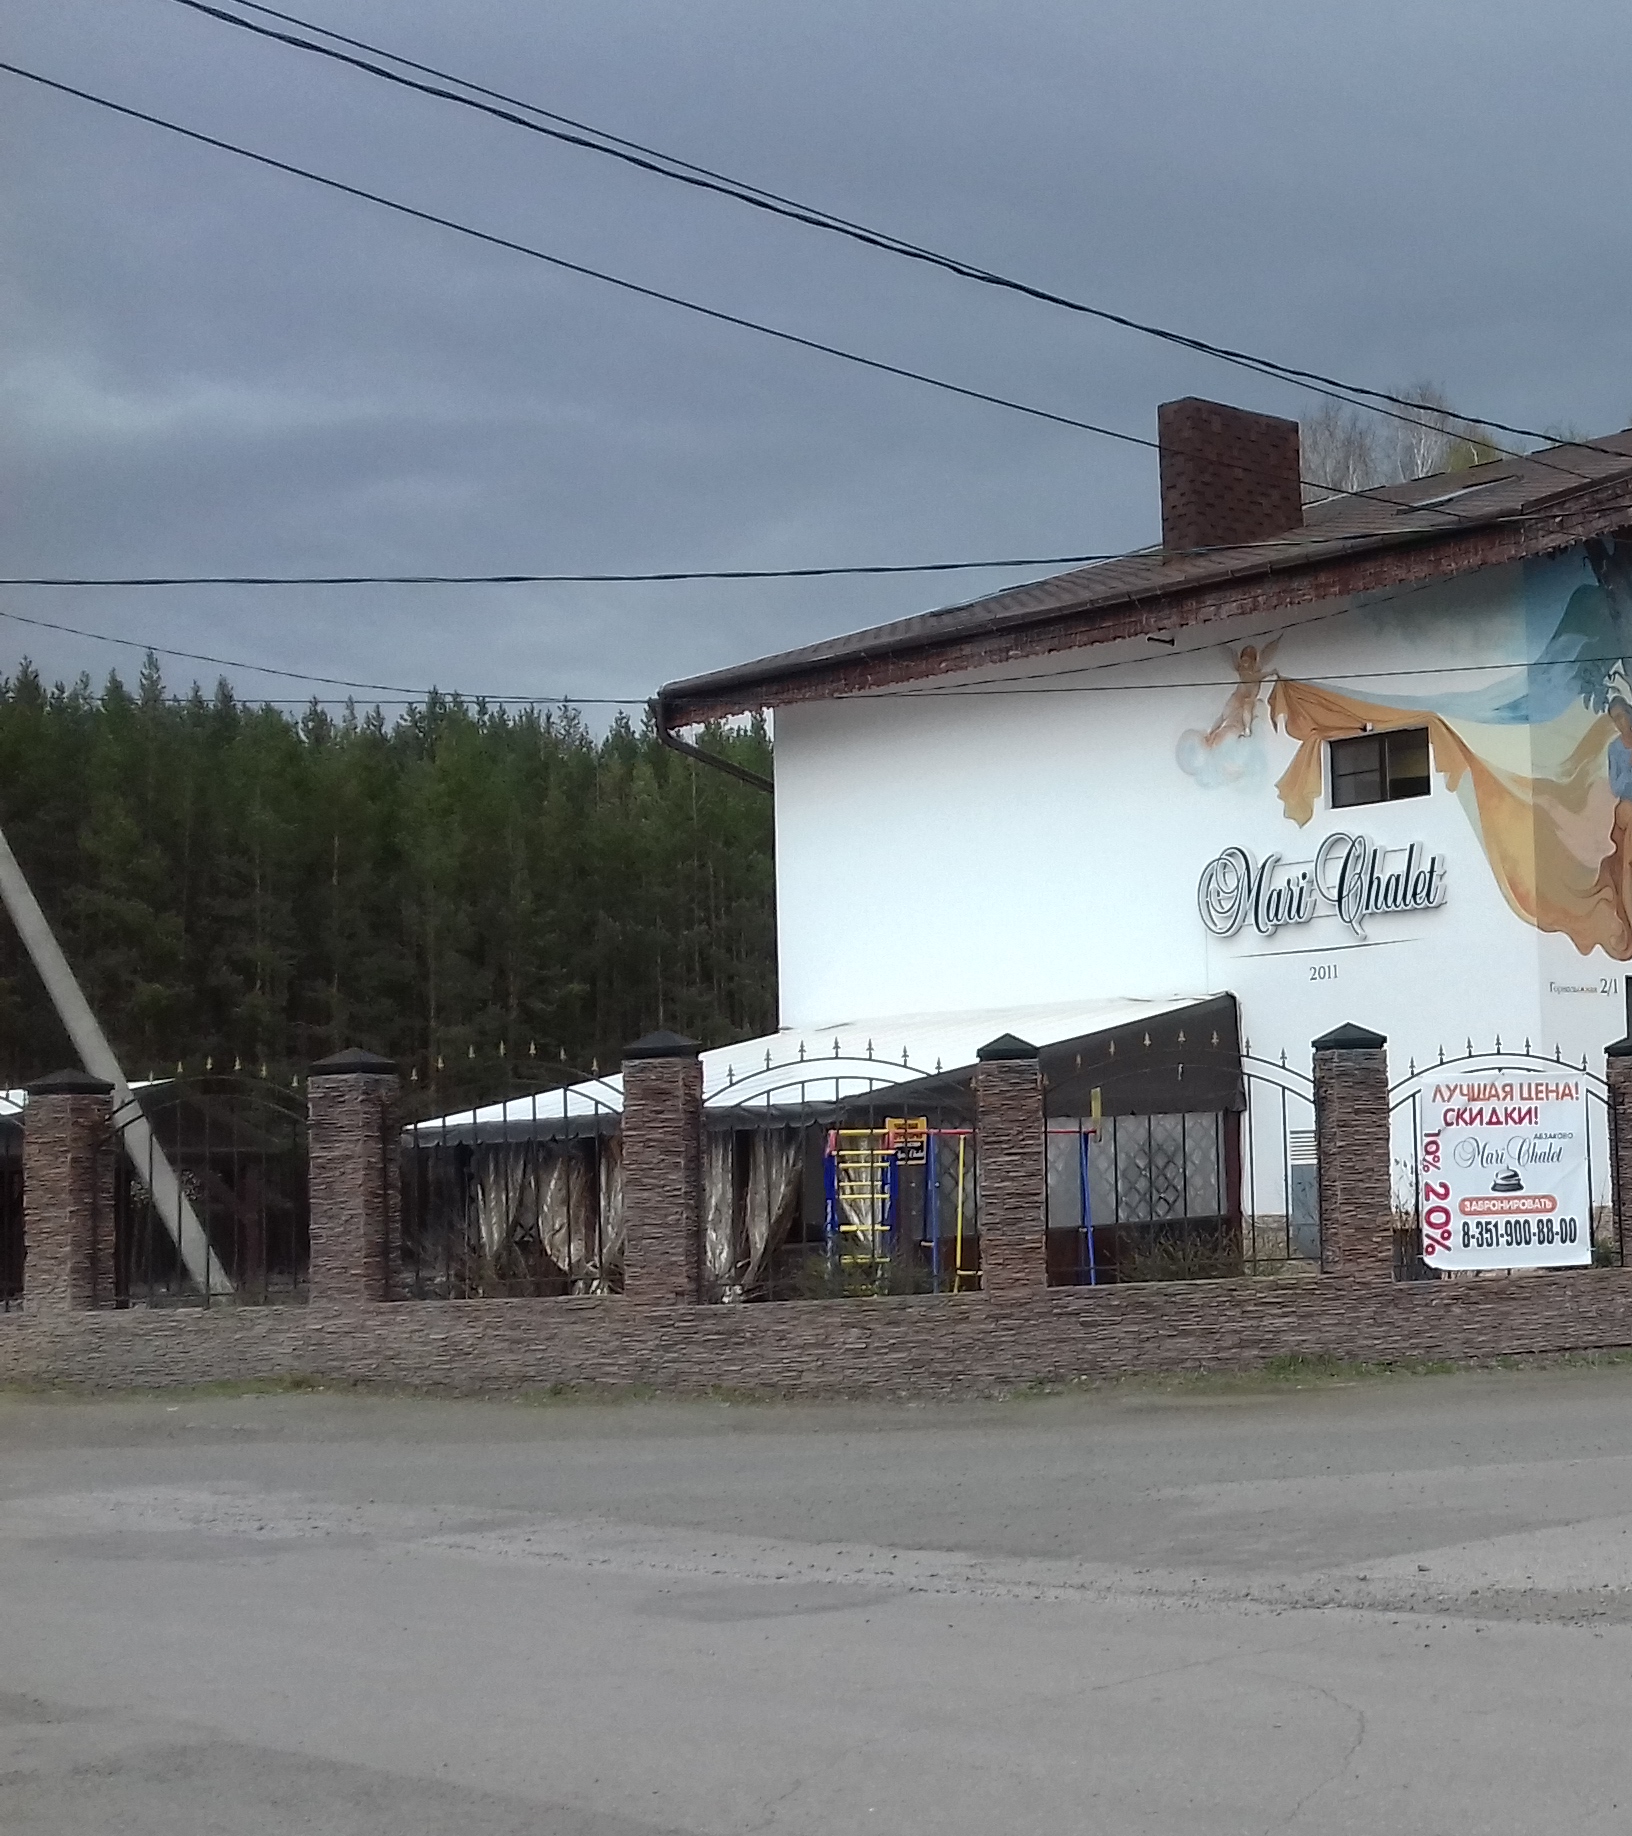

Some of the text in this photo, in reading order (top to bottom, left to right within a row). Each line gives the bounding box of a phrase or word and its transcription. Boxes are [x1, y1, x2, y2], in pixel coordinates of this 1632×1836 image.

[1198, 832, 1440, 937] Mari Chalet
[1309, 964, 1338, 981] 2011
[1600, 978, 1618, 996] 2/1
[1431, 1081, 1580, 1104] ЛУЧШАЯ ЦЕНА!
[1443, 1106, 1539, 1127] СКИДКИ!
[1422, 1129, 1442, 1174] 10%
[1453, 1135, 1563, 1172] Mari Chalet
[1424, 1181, 1453, 1257] 20%
[1464, 1198, 1553, 1212] ЗАБРОНИРОВАТЬ
[1461, 1216, 1578, 1249] 8-351-900-88-00
